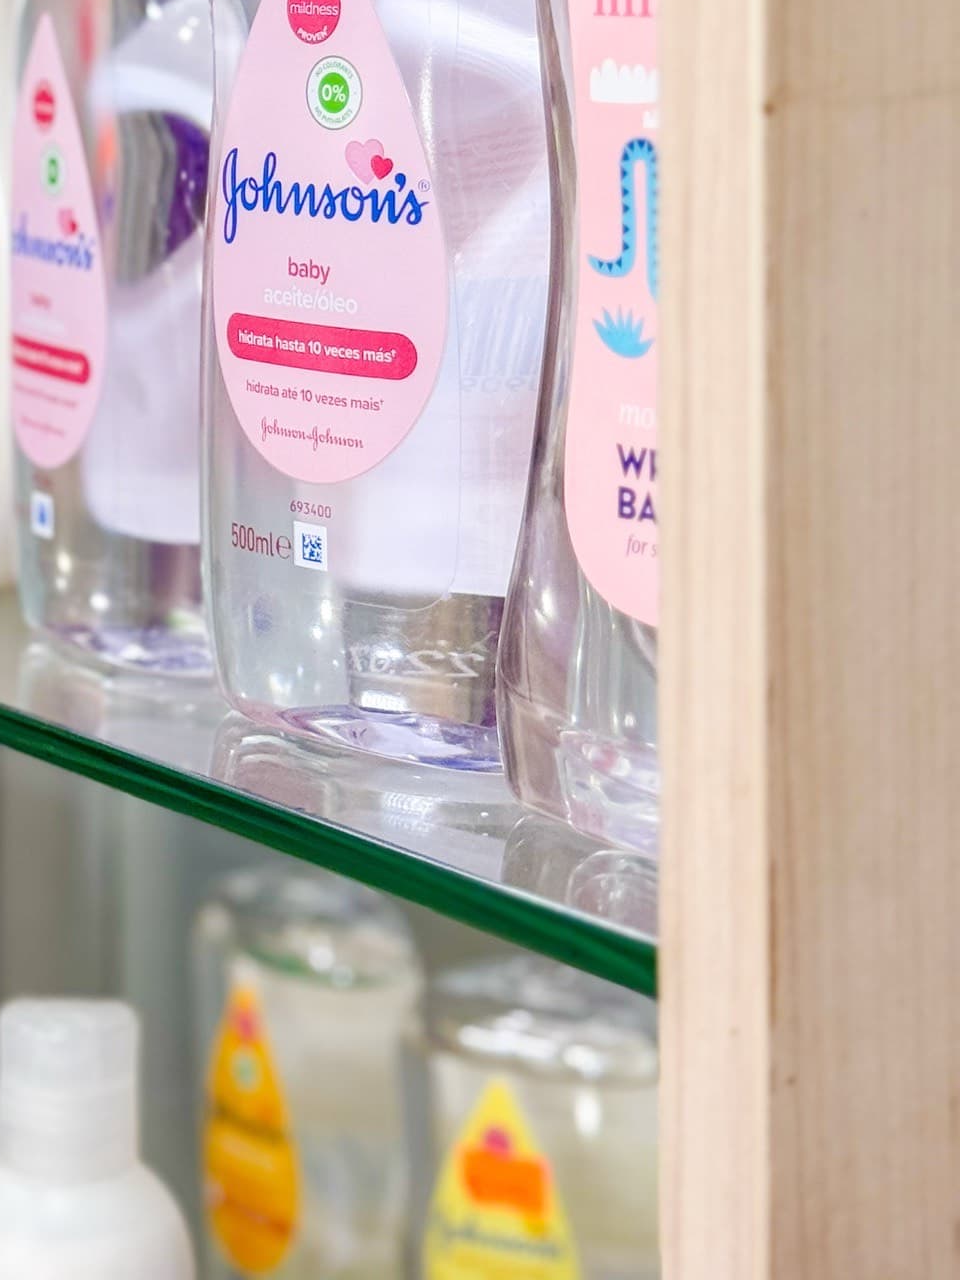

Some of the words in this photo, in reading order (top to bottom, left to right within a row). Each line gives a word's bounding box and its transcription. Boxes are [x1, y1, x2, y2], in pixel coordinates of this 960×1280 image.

[290, 2, 340, 17] mildness
[321, 84, 347, 103] 0%
[288, 256, 331, 285] baby
[263, 285, 359, 315] aceite/óleo
[238, 329, 274, 348] hidrata
[276, 335, 306, 354] hasta
[308, 340, 321, 355] 10
[324, 346, 360, 361] veces
[246, 379, 280, 398] hidrata
[281, 386, 298, 401] até
[300, 389, 313, 403] 10
[315, 394, 348, 408] vezes
[290, 500, 332, 519] 693400
